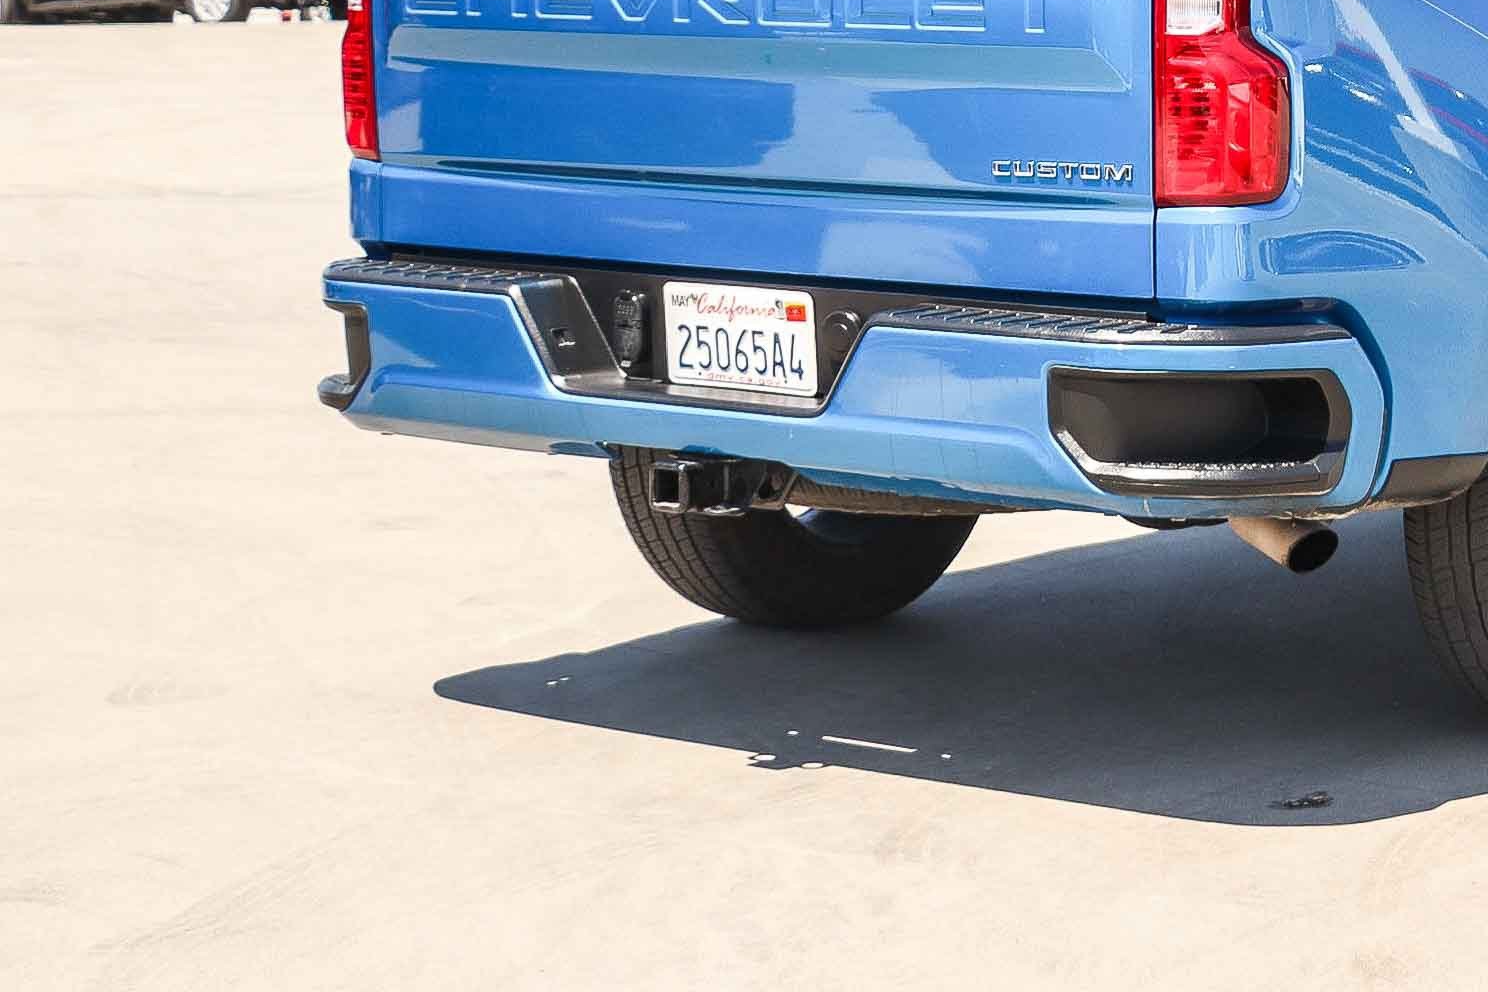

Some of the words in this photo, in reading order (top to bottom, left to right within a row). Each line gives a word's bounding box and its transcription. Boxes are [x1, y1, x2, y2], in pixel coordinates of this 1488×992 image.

[991, 159, 1133, 182] CUSTOM
[671, 294, 689, 307] MAY
[697, 292, 776, 323] California
[678, 324, 803, 380] 25065A4
